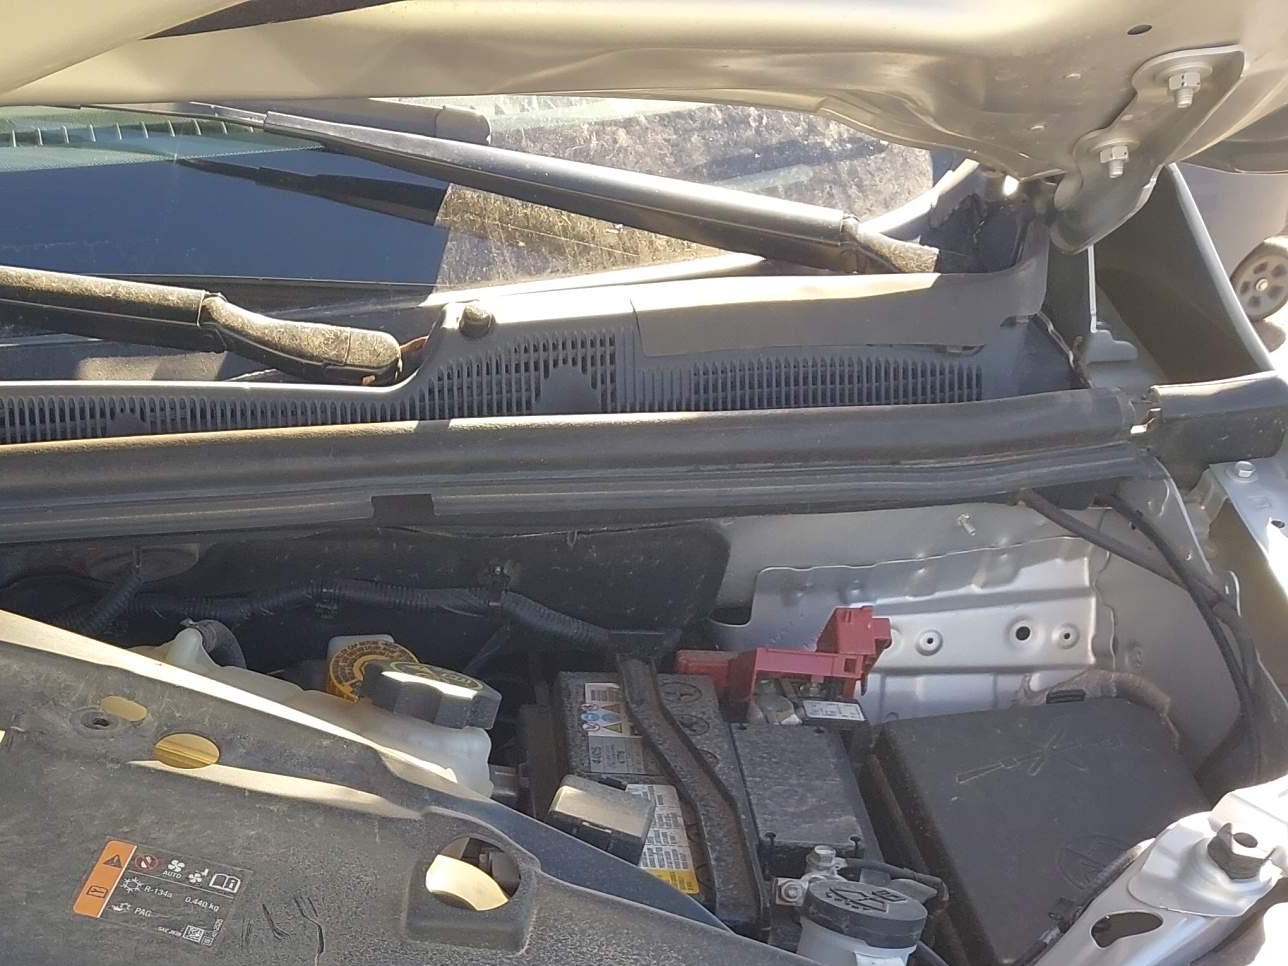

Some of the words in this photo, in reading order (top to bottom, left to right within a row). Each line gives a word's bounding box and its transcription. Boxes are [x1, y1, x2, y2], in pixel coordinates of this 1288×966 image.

[162, 870, 182, 879] AUTO
[144, 886, 173, 898] R-134a
[184, 896, 208, 908] 0.440
[208, 903, 220, 912] kg
[134, 907, 153, 917] PAG
